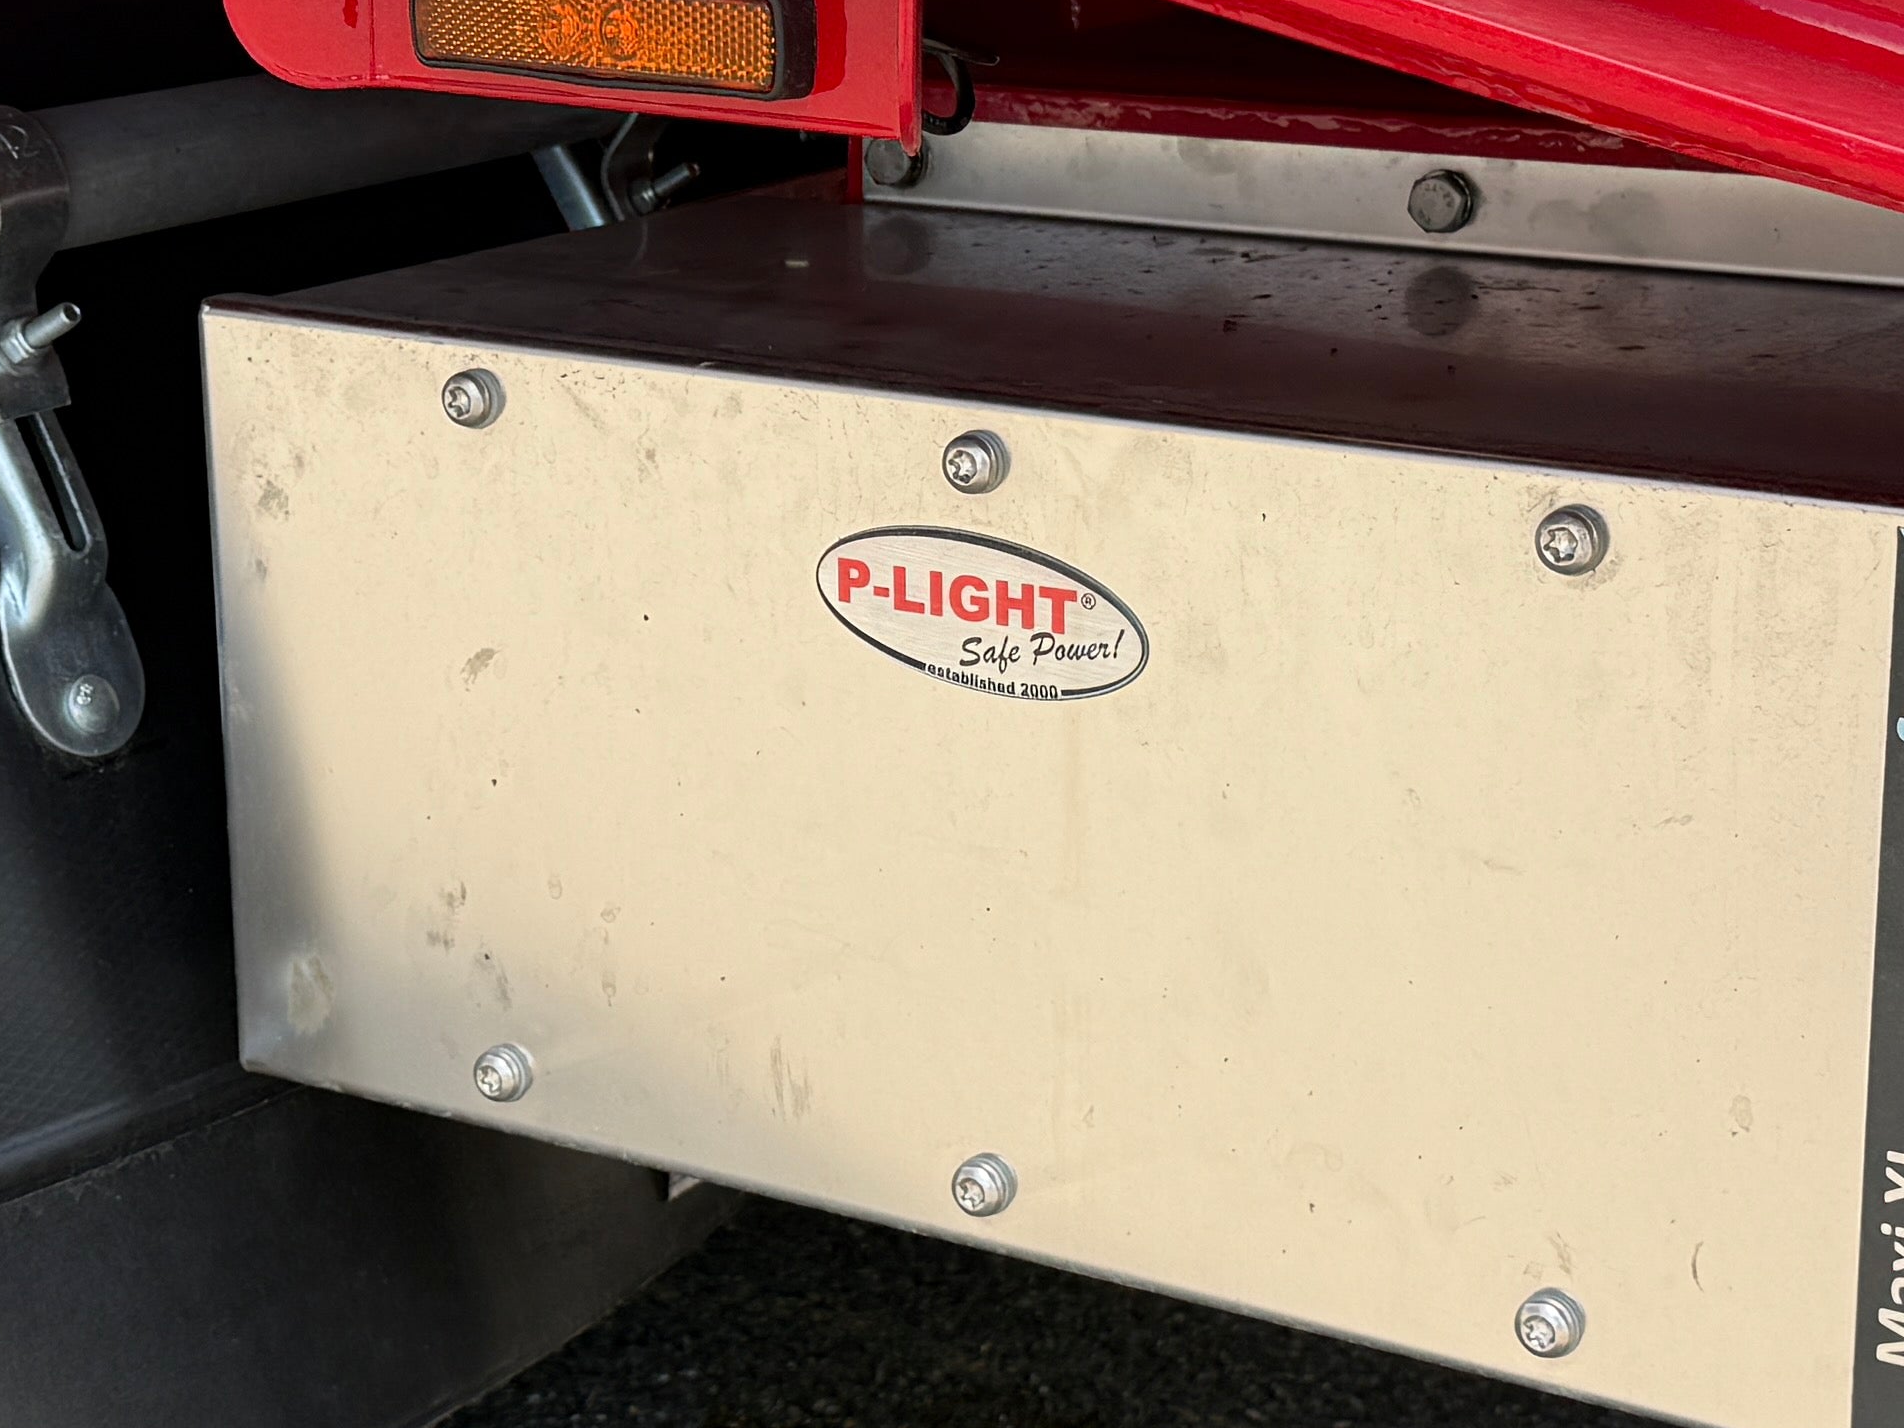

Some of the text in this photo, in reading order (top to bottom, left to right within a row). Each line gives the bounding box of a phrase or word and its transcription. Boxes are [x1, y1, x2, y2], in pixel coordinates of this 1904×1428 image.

[959, 629, 1125, 674] Safe Power!
[925, 662, 1058, 700] established 2000
